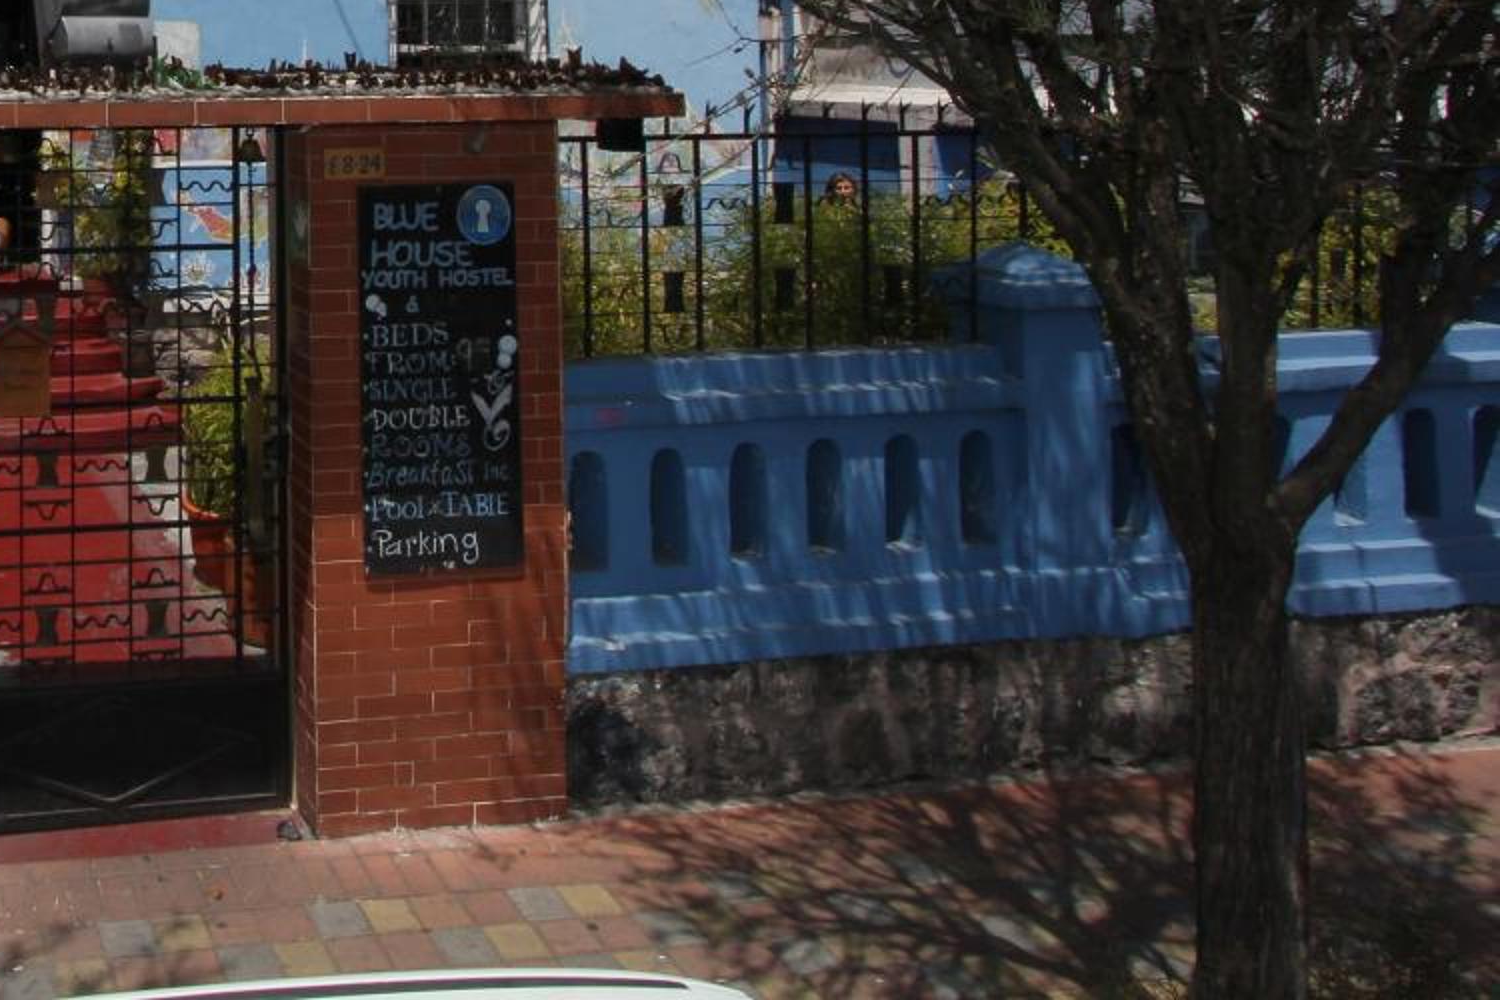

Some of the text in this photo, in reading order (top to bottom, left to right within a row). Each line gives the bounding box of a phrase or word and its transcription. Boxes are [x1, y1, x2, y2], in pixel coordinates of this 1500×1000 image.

[373, 201, 440, 231] BLUE
[371, 239, 473, 268] HOUSE
[361, 266, 514, 290] YOUTH HOSTEL
[372, 321, 450, 347] BEDS
[369, 376, 457, 403] SINGLE
[371, 402, 472, 432] DOUBLE
[371, 432, 473, 459] ROOMS
[372, 528, 480, 565] Parking
